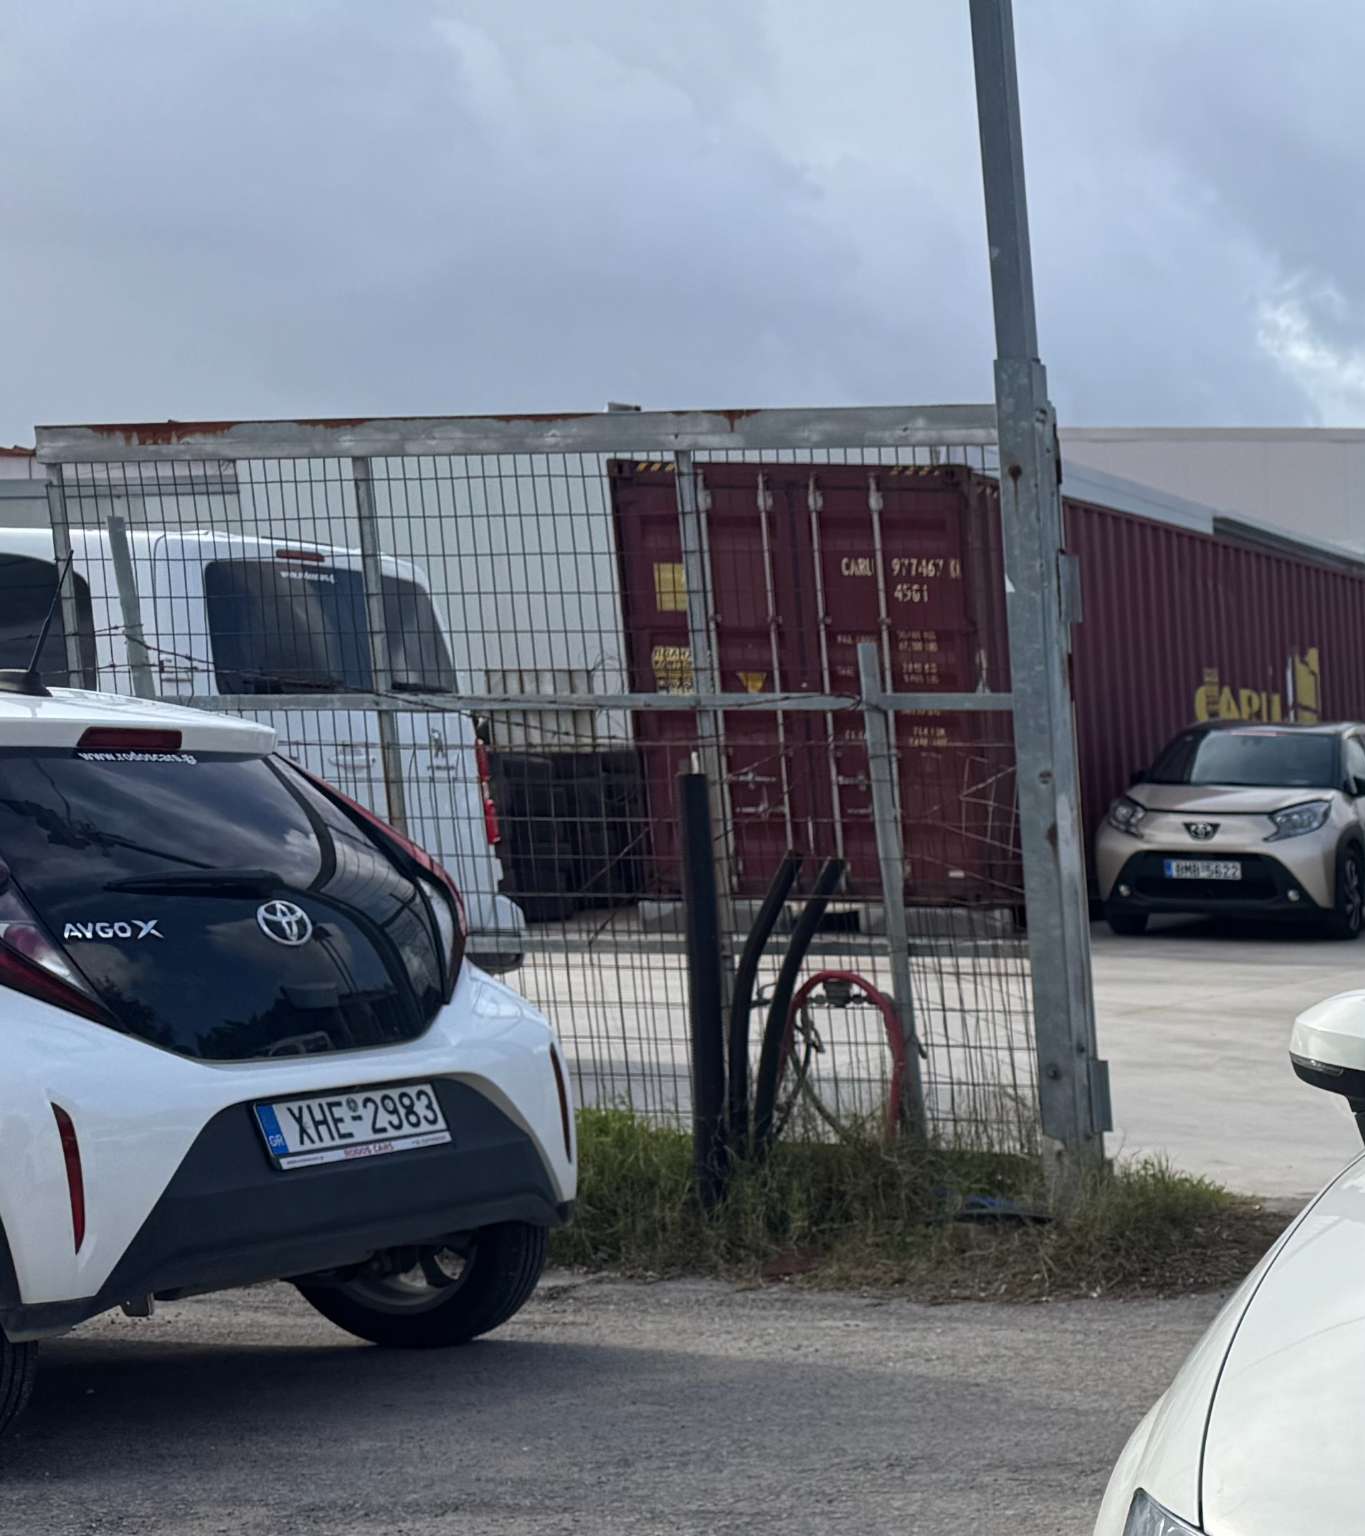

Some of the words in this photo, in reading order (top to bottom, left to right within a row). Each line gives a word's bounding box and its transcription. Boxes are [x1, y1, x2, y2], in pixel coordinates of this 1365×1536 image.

[63, 921, 132, 940] AYGO
[131, 919, 165, 940] X
[286, 1088, 439, 1147] XHE-2983
